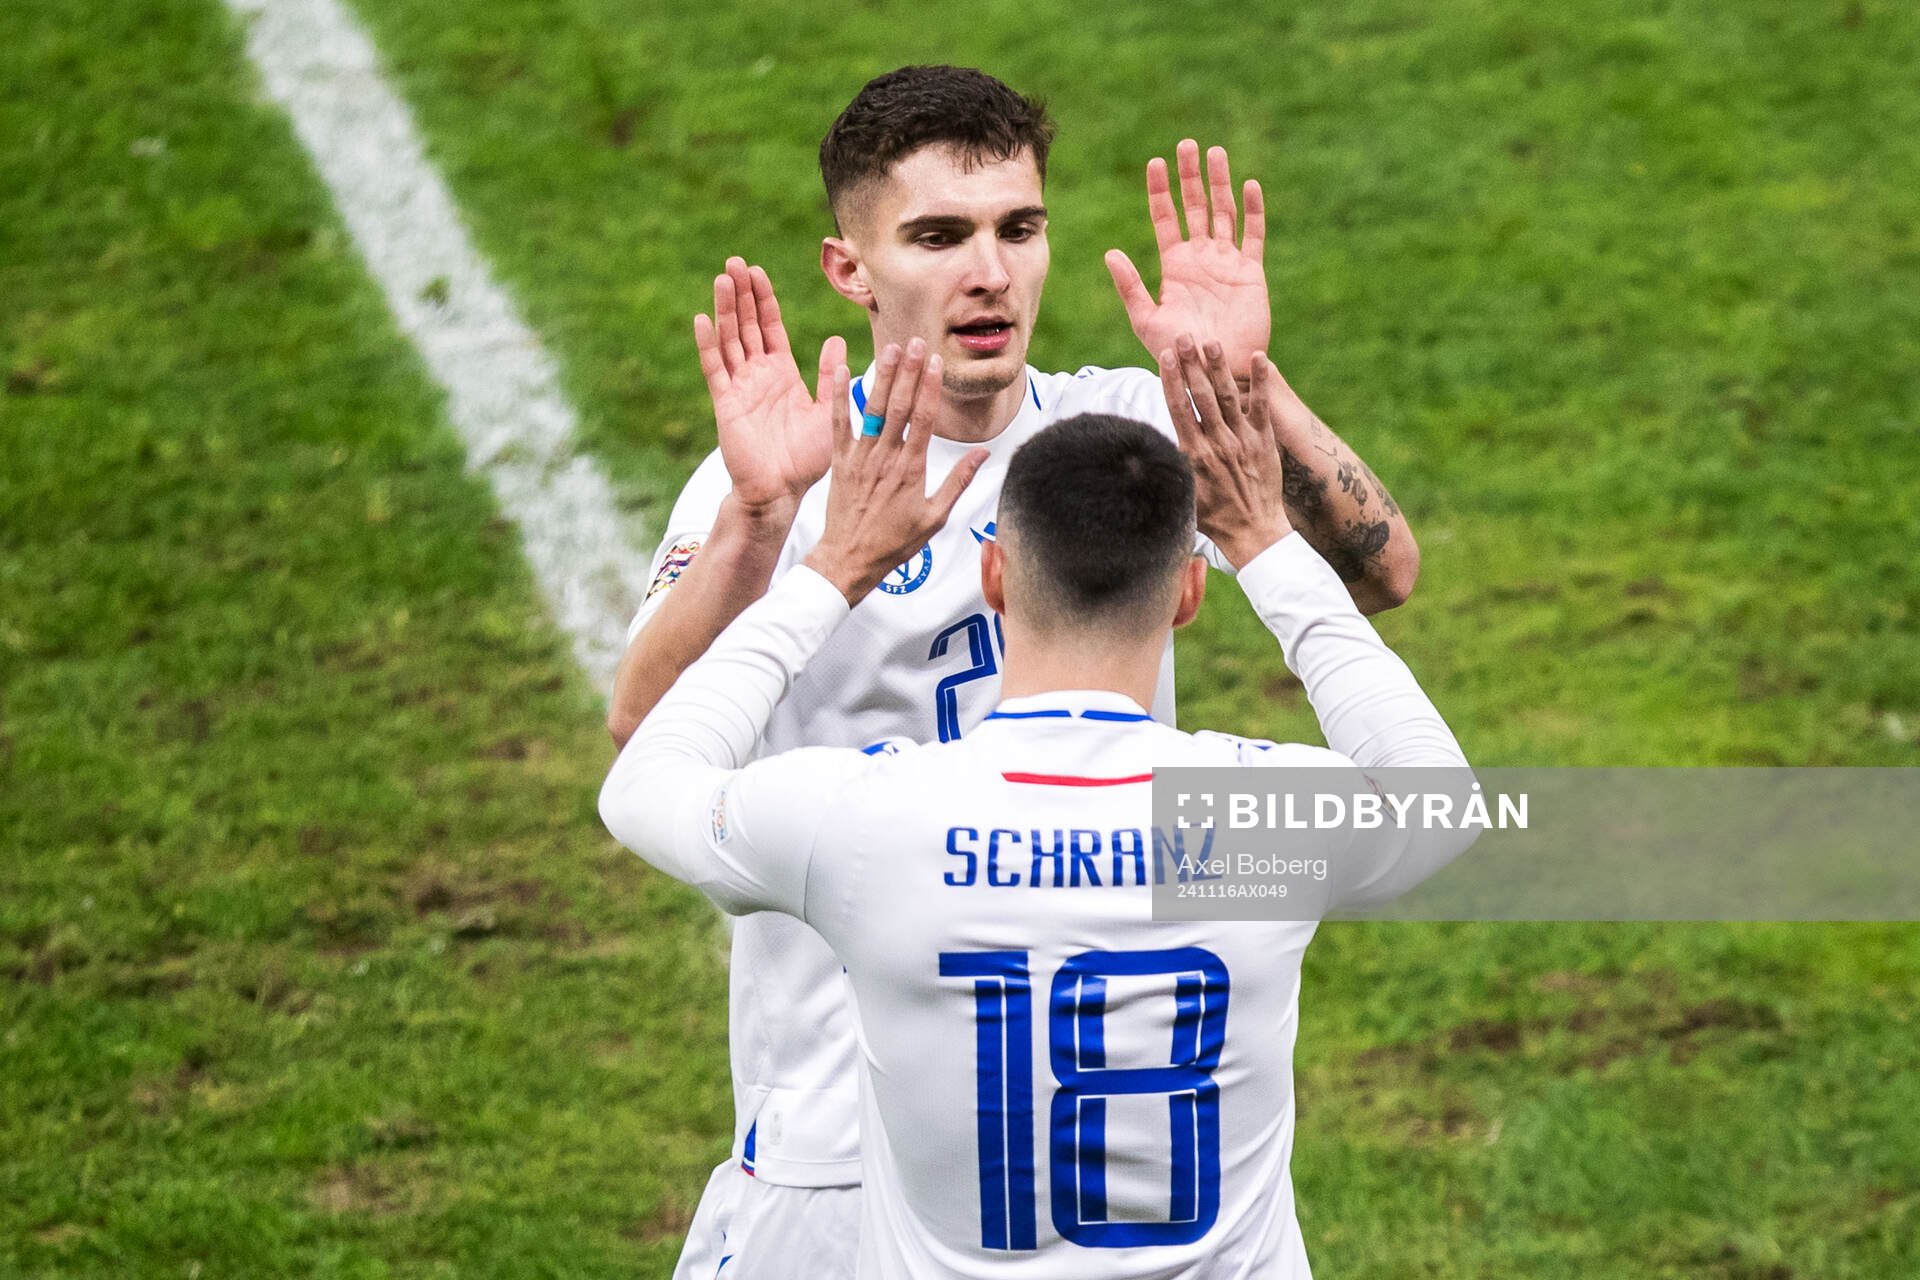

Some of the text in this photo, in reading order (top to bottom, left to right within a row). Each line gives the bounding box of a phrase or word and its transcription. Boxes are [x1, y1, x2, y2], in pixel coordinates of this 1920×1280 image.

[886, 584, 907, 594] SFZ
[927, 613, 1005, 744] 2
[943, 821, 1223, 889] SCHRANZ
[938, 946, 1230, 1250] 18
